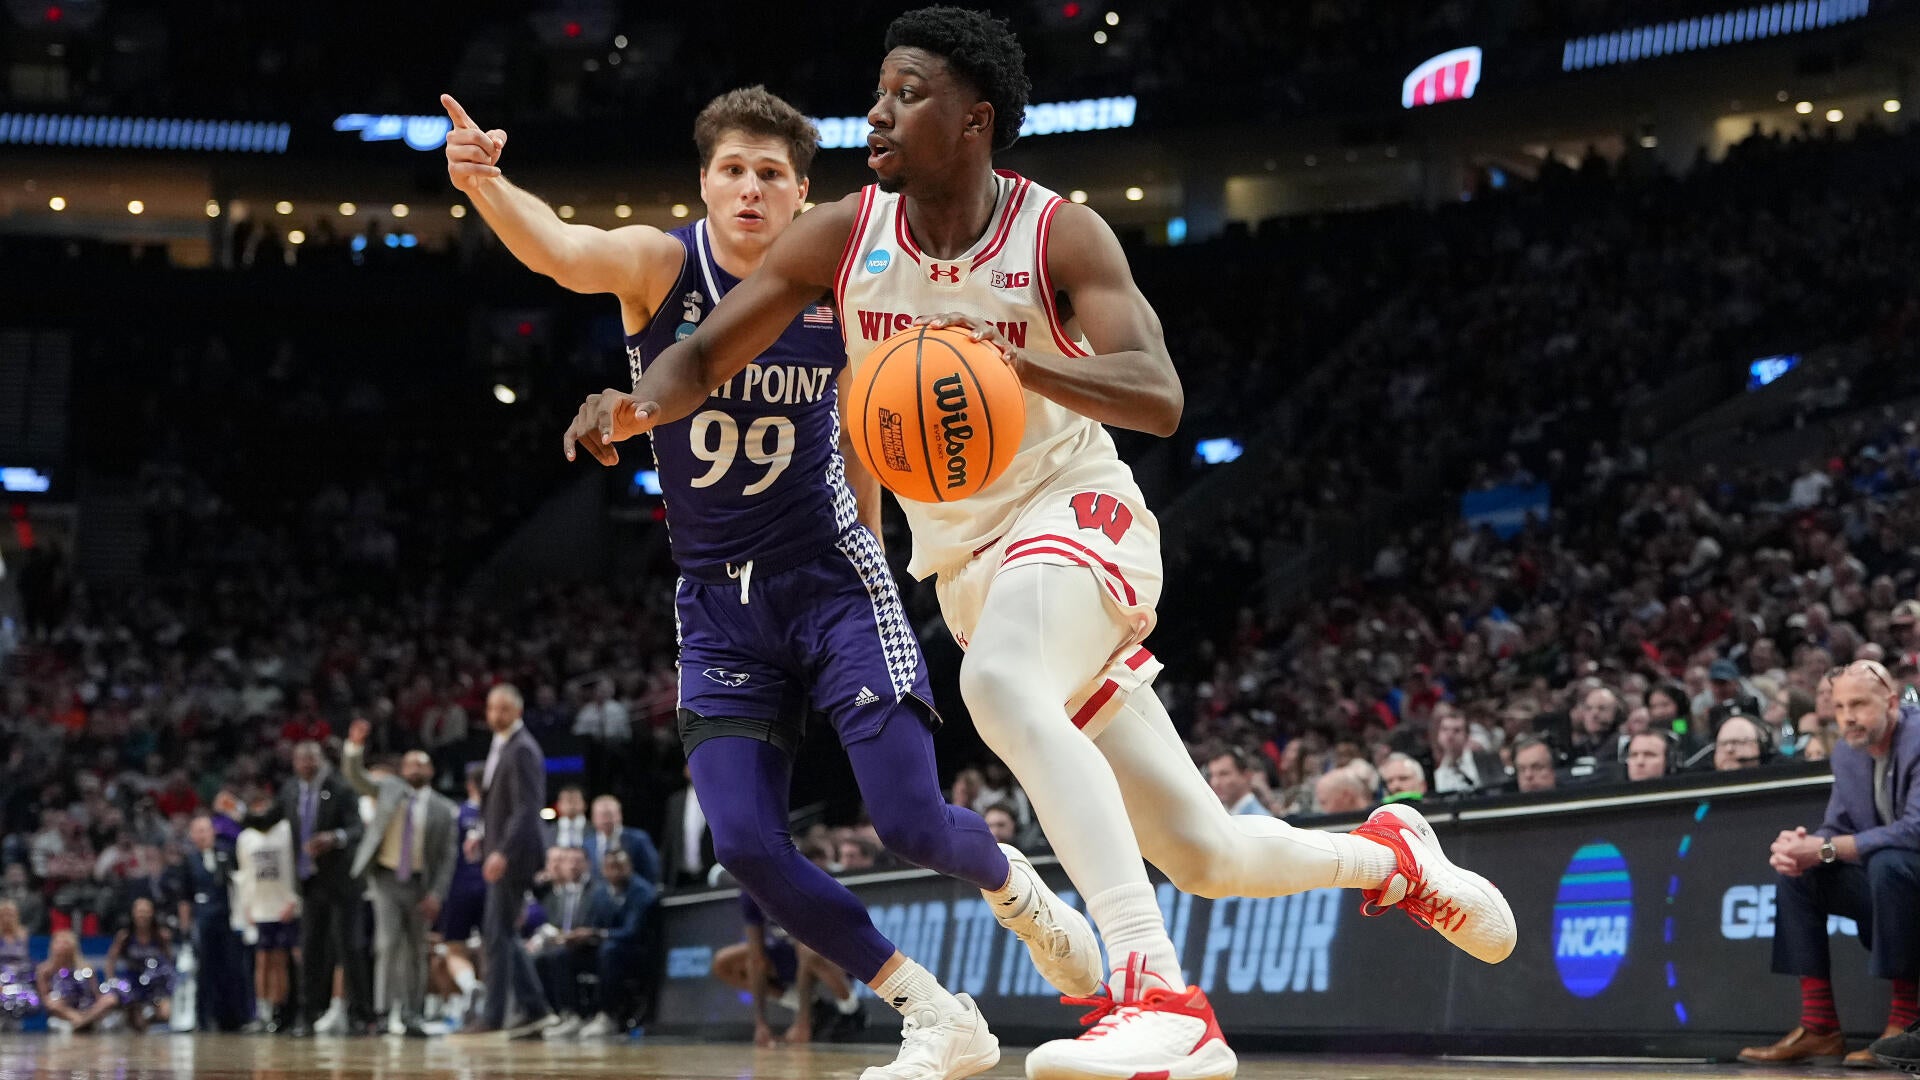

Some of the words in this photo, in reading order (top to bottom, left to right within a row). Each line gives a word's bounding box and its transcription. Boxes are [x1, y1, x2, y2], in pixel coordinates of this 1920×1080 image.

[1019, 95, 1137, 137] CONSIN
[742, 363, 832, 404] POINT
[892, 424, 905, 459] MARCH
[933, 372, 973, 489] Wilson
[689, 409, 796, 496] 99
[1069, 492, 1133, 545] W
[855, 696, 879, 706] adidas
[1200, 887, 1342, 993] FOUR
[1557, 916, 1628, 957] NCAA
